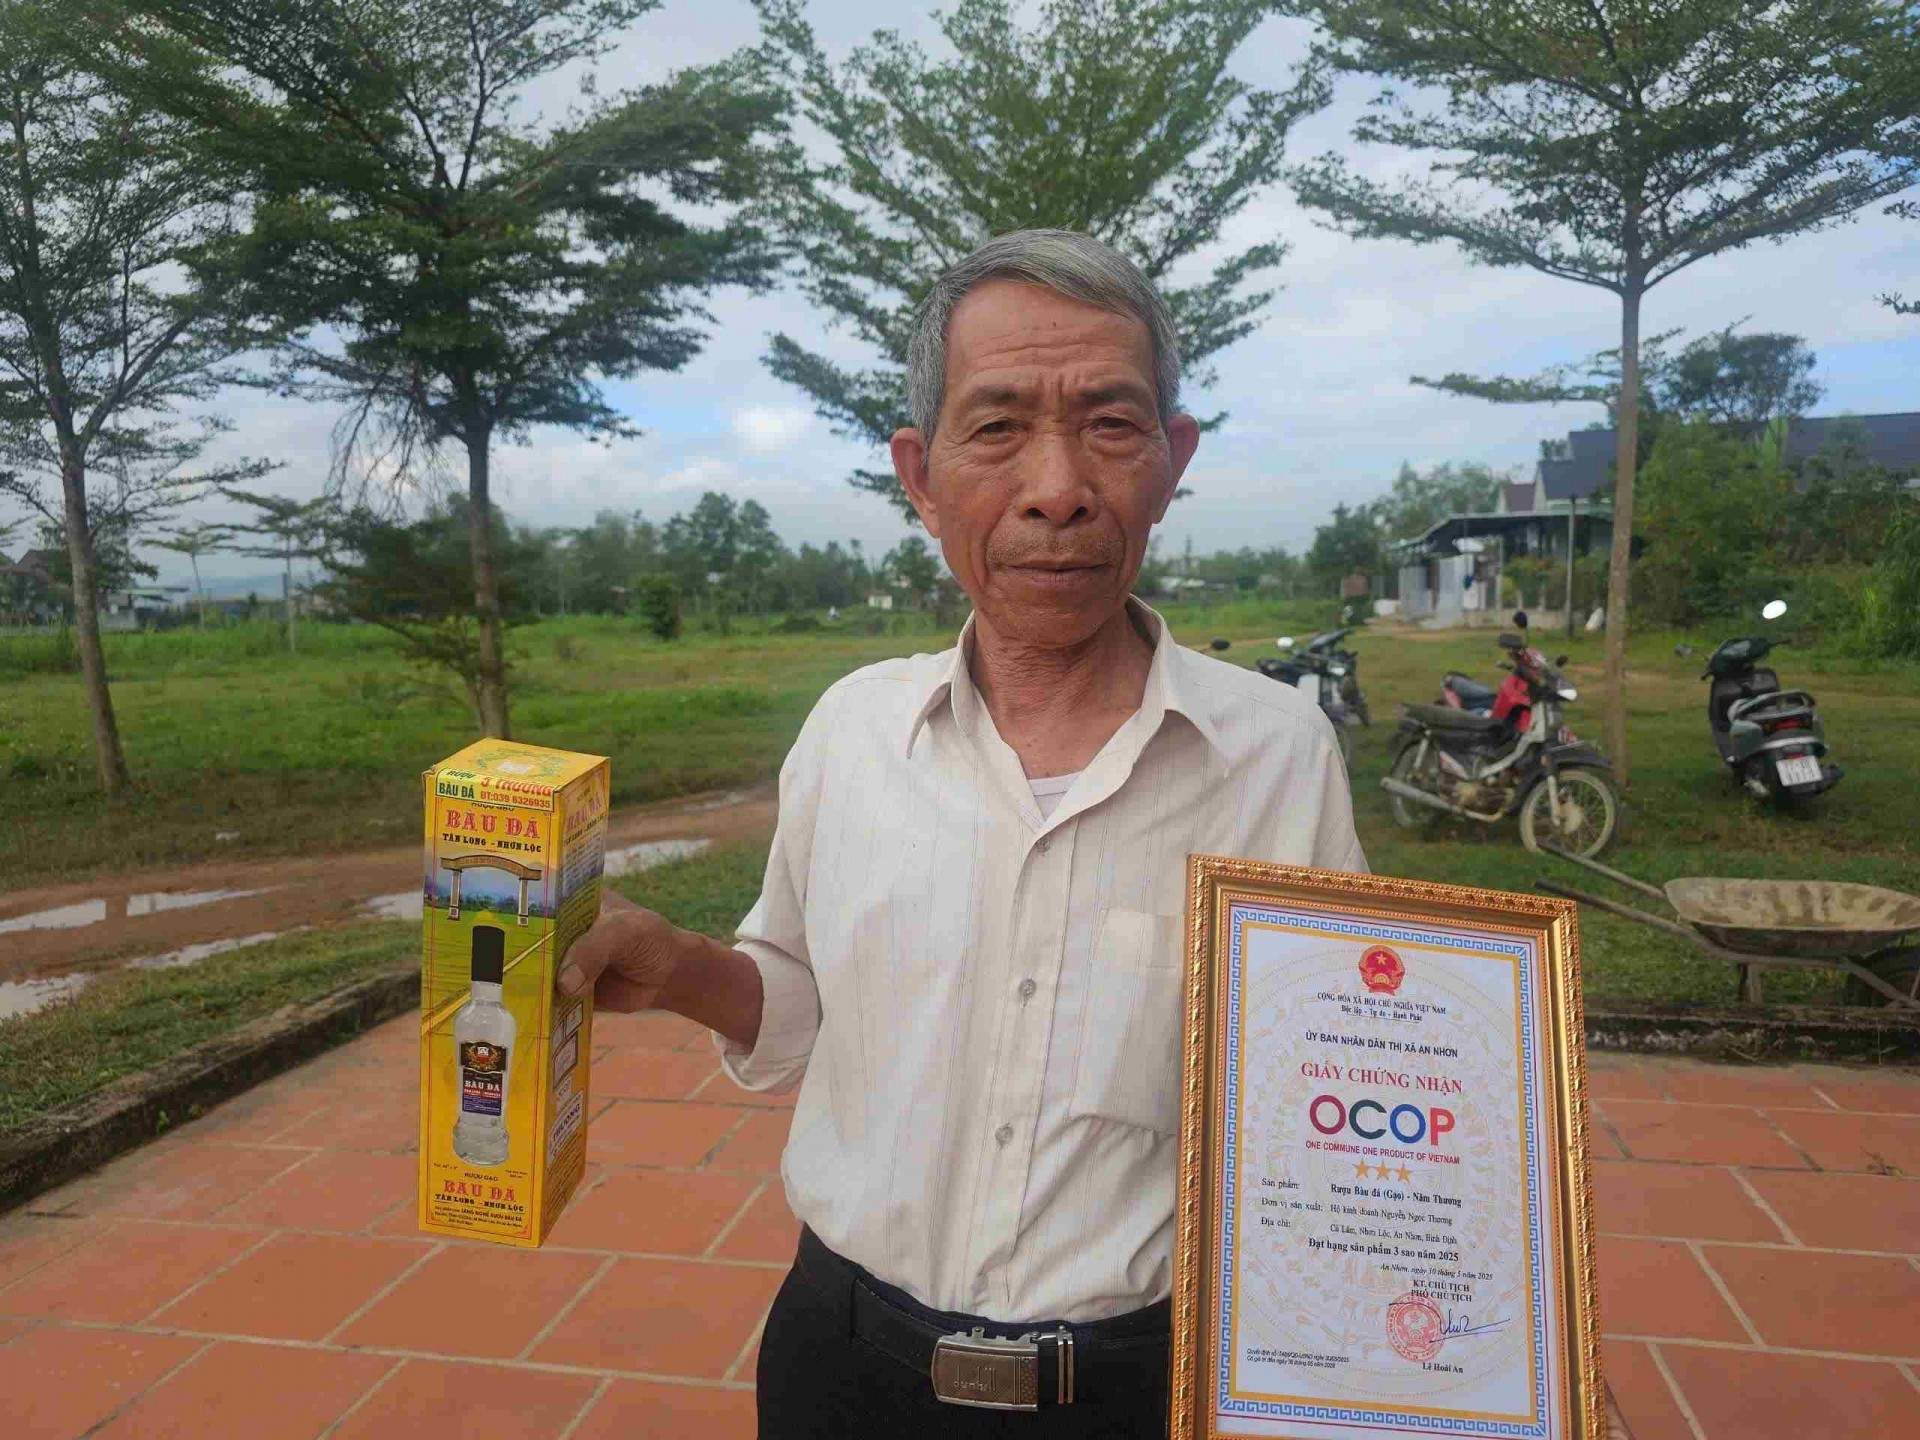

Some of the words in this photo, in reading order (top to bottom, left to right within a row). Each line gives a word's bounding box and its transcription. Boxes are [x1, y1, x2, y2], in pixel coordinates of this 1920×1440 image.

[439, 782, 458, 796] BÀU
[461, 785, 475, 799] ĐÁ
[446, 809, 498, 833] BÀU
[505, 816, 541, 839] ĐÁ
[442, 833, 461, 843] TÂN
[463, 836, 487, 846] LONG
[524, 843, 542, 853] LỘC
[1317, 992, 1336, 1002] CỘNG
[1353, 995, 1362, 1004] XÃ
[1364, 997, 1376, 1007] HỘI
[1416, 1004, 1429, 1014] VIỆT
[1432, 1006, 1446, 1015] NAM
[1306, 1030, 1318, 1041] ỦY
[1320, 1033, 1338, 1044] BAN
[1341, 1035, 1365, 1047] NHÂN
[1368, 1038, 1386, 1050] DÂN
[1389, 1041, 1402, 1054] THỊ
[1404, 1043, 1416, 1054] XÃ
[1418, 1045, 1431, 1055] AN
[1434, 1047, 1458, 1058] NHƠN
[1301, 1060, 1344, 1080] GIẤY
[1348, 1066, 1410, 1088] CHỨNG
[1416, 1074, 1462, 1096] NHẬN
[1309, 1094, 1456, 1146] OCOP
[1306, 1140, 1321, 1150] ONE
[1324, 1141, 1360, 1154] COMMUNE
[1362, 1146, 1378, 1156] ONE
[1380, 1148, 1414, 1160] PRODUCT
[1416, 1152, 1426, 1161] OF
[1428, 1153, 1460, 1165] VIETNAM
[444, 1179, 482, 1197] BÀU
[490, 1186, 516, 1202] ĐÁ
[1331, 1184, 1352, 1196] Rượu
[1354, 1186, 1369, 1197] Bàu
[1372, 1188, 1381, 1198] đá
[1384, 1188, 1405, 1201] (Gạo)
[1432, 1194, 1462, 1208] Thương
[1261, 1196, 1278, 1207] Đơn
[1260, 1216, 1274, 1227] Địa
[1330, 1204, 1341, 1214] Hộ
[1342, 1205, 1358, 1215] kinh
[1360, 1207, 1379, 1218] doanh
[1382, 1208, 1406, 1220] Nguyễn
[1408, 1212, 1426, 1223] Ngọc
[1394, 1230, 1403, 1239] An
[1308, 1237, 1324, 1250] Đạt
[1326, 1239, 1348, 1254] hạng
[1350, 1243, 1365, 1253] sản
[1368, 1242, 1391, 1256] phẩm
[1394, 1246, 1399, 1256] 3
[1401, 1249, 1416, 1258] sao
[1417, 1249, 1436, 1260] năm
[1438, 1251, 1459, 1262] 2025
[1438, 1268, 1456, 1278] tháng
[1457, 1270, 1461, 1278] 5
[1462, 1272, 1476, 1280] năm
[1478, 1272, 1494, 1280] 2025
[1411, 1287, 1429, 1298] PHÓ
[1430, 1289, 1450, 1300] CHỦ
[1451, 1292, 1472, 1303] TỊCH
[1428, 1279, 1447, 1290] CHỦ
[1449, 1282, 1470, 1292] TỊCH
[1453, 1366, 1464, 1374] An
